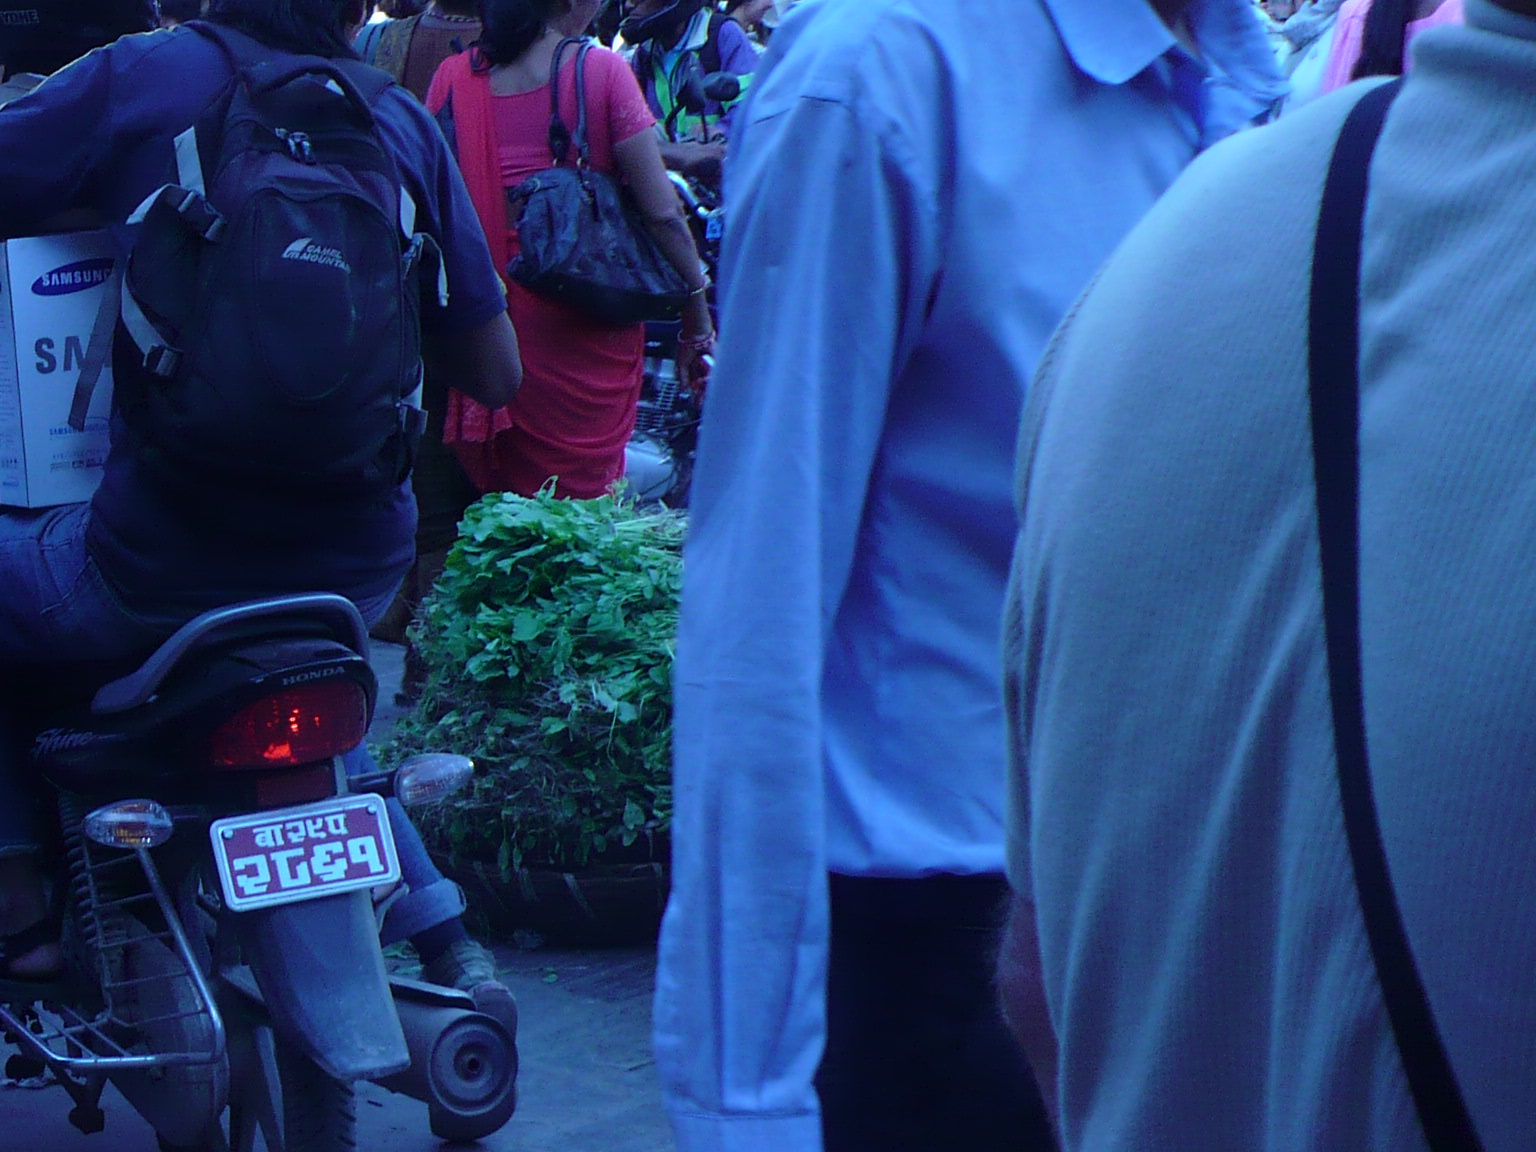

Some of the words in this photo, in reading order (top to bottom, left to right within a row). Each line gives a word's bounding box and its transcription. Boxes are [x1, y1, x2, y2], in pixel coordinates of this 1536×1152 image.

[299, 251, 353, 274] MOUNTA
[305, 244, 343, 259] CAMEL
[282, 665, 347, 686] HONDA
[232, 835, 385, 895] २८६१
